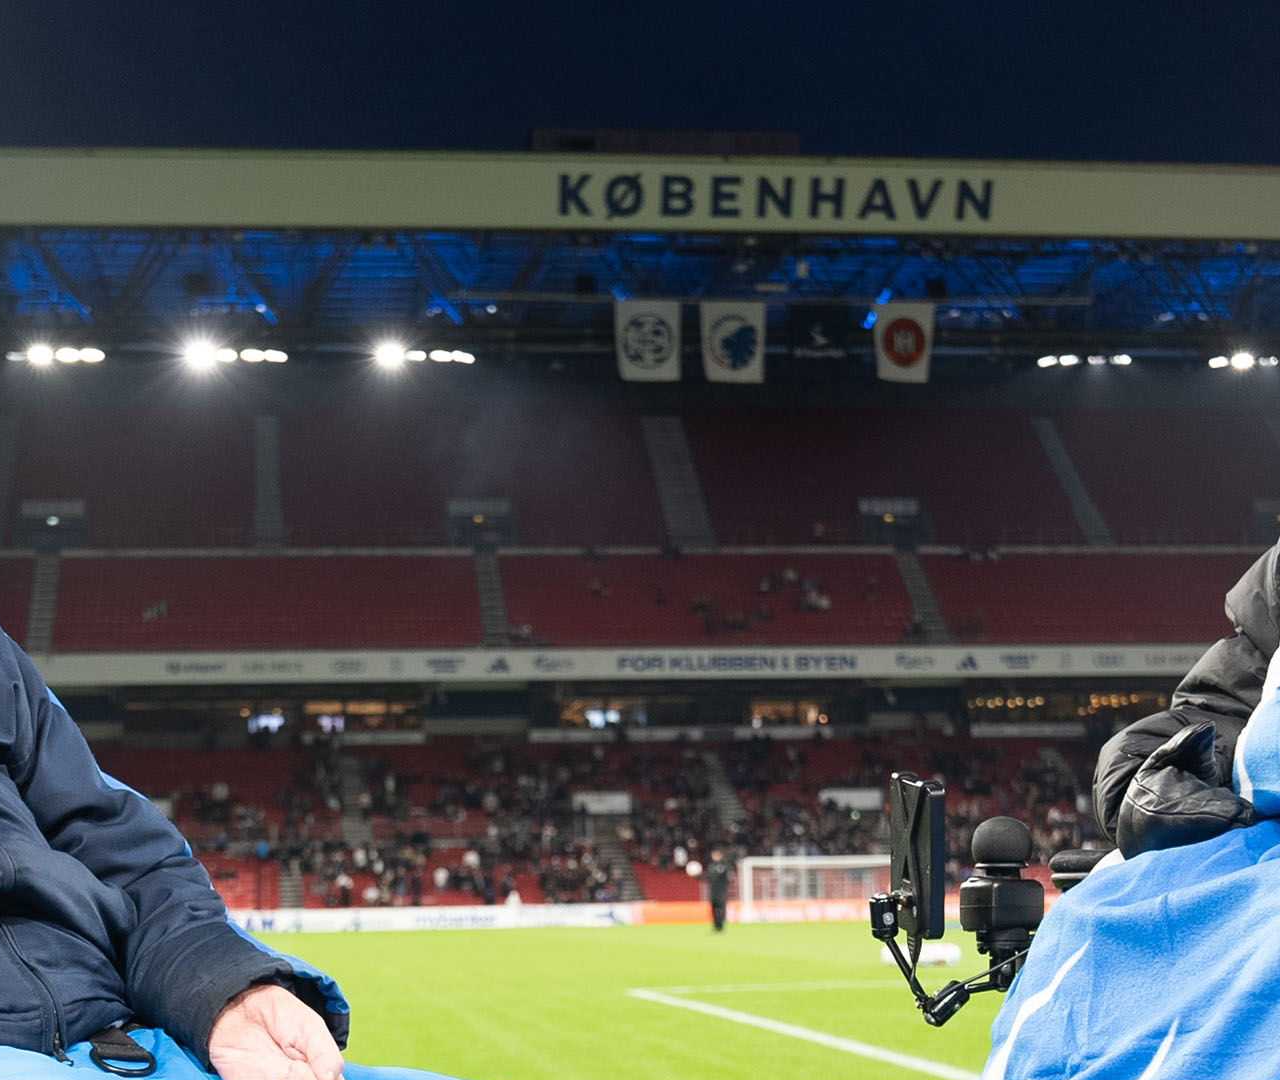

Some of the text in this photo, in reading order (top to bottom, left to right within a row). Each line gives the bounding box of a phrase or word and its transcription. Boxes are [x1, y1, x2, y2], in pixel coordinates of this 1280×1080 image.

[558, 173, 994, 220] KØBENHAVN
[617, 655, 664, 672] FOR
[669, 655, 776, 672] KLUBBEN
[795, 655, 857, 672] BYEN
